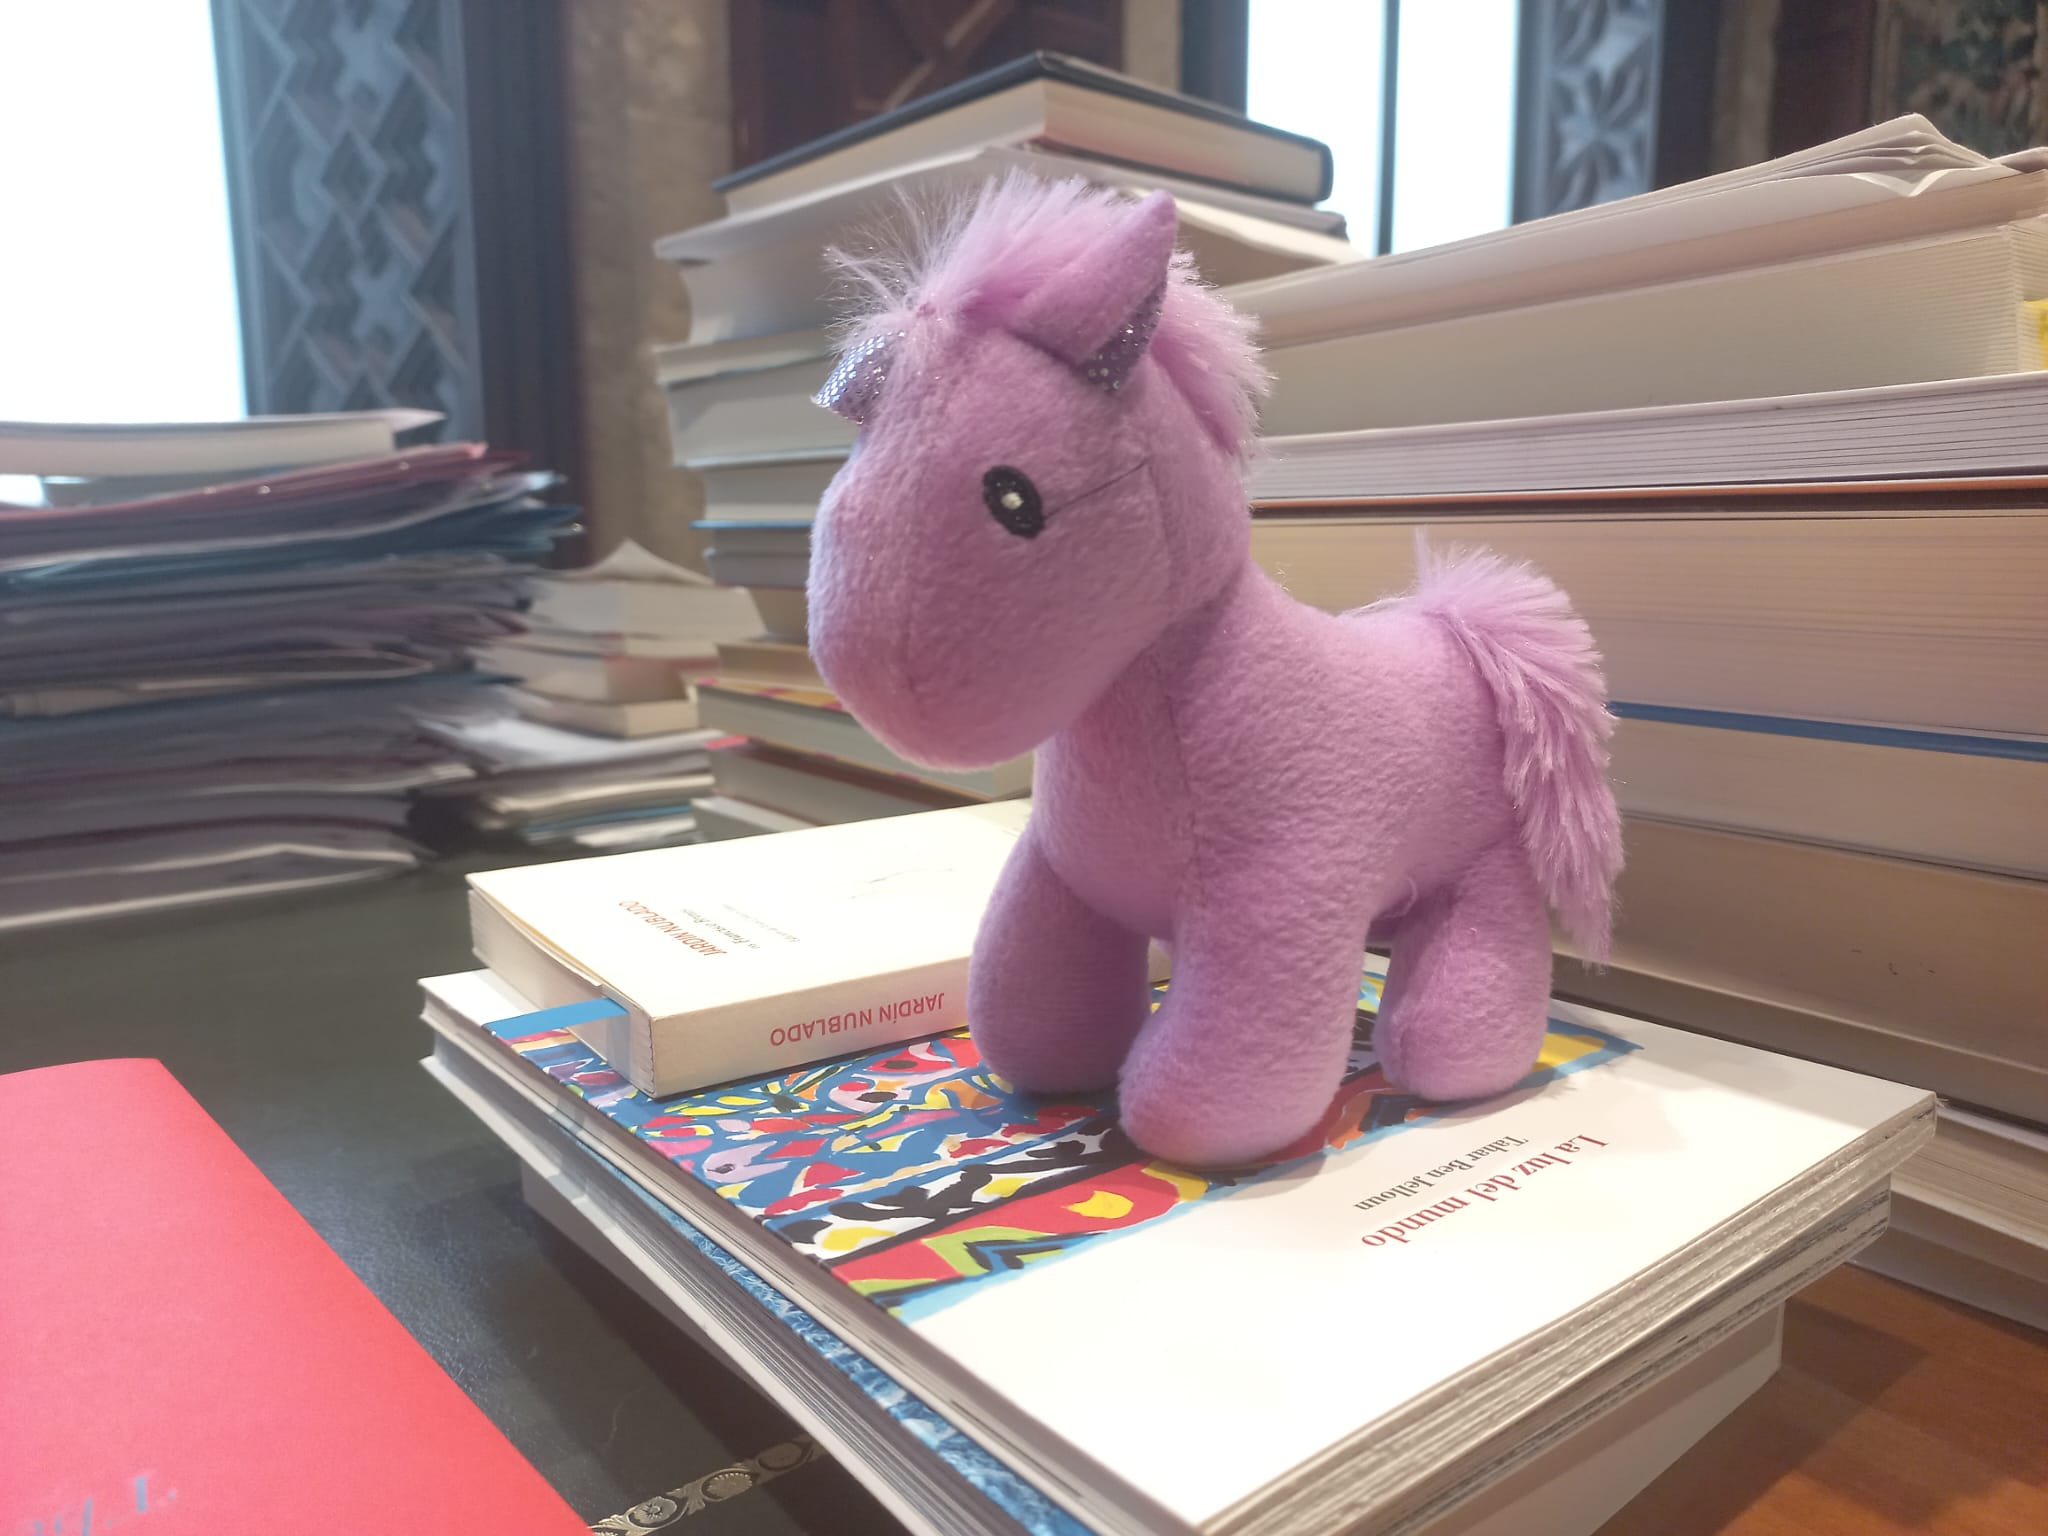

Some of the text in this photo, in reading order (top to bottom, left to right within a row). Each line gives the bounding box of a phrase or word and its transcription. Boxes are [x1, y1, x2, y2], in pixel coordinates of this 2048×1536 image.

[770, 993, 945, 1046] JARDÍN NUBLADO
[1354, 1136, 1529, 1210] Tahar Ben Jelloun
[1361, 1134, 1609, 1246] La luz del mundo
